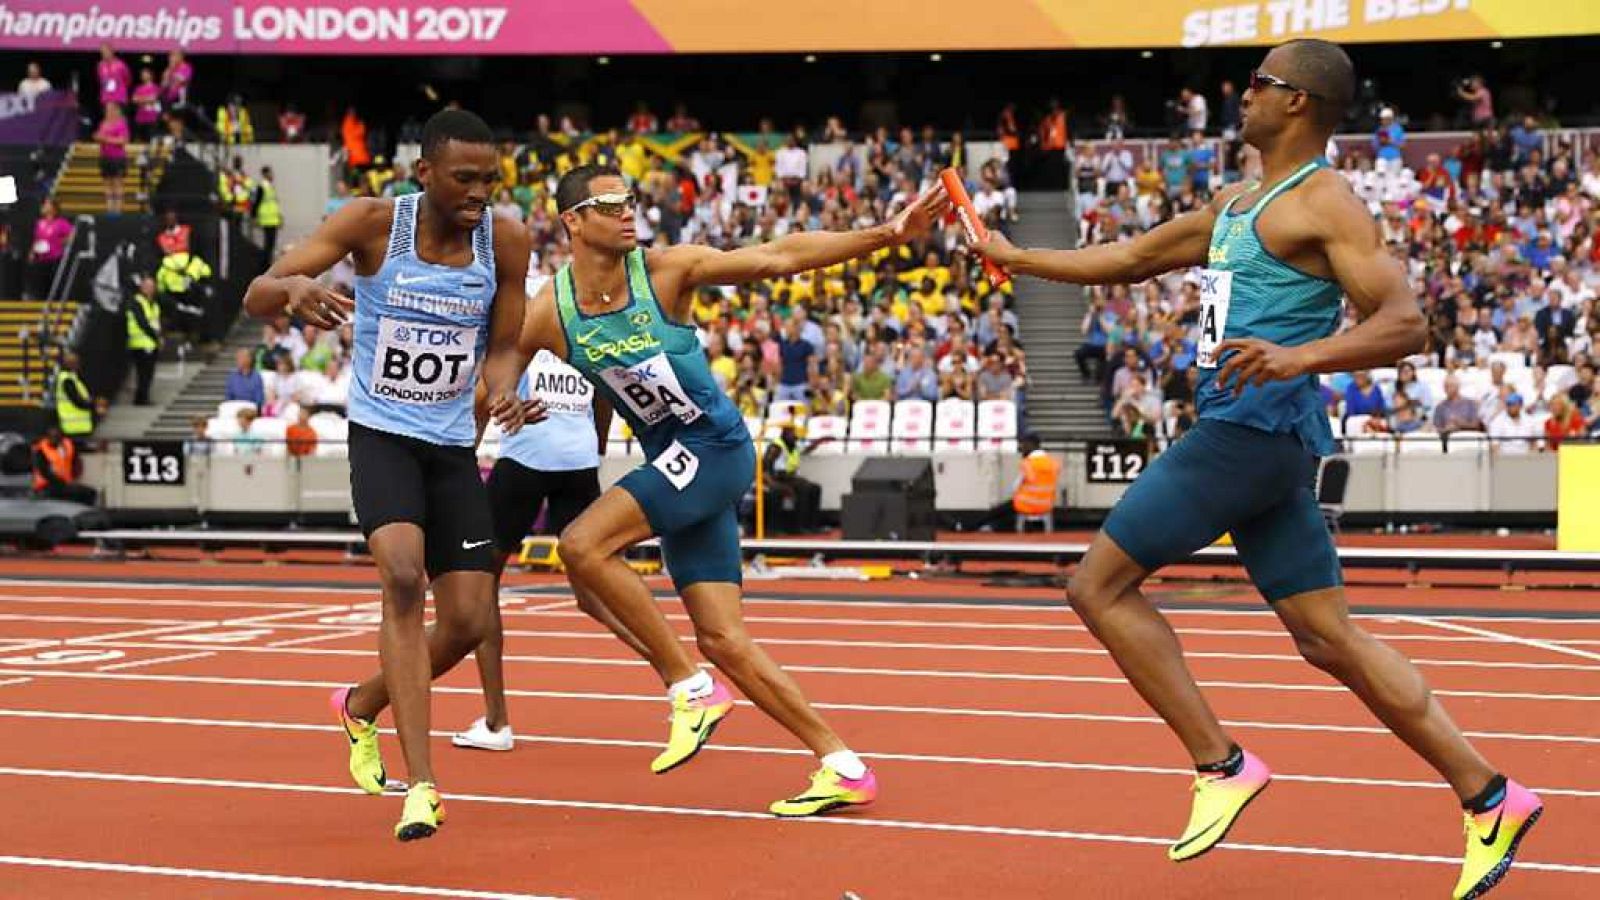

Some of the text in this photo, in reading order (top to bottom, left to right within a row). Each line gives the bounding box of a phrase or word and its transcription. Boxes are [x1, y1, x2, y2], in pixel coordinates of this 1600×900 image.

[233, 7, 409, 41] LONDON
[414, 8, 507, 42] 2017
[1182, 6, 1259, 48] SEE
[1267, 0, 1350, 36] THE
[1199, 304, 1217, 343] A
[383, 347, 468, 385] BOT
[374, 383, 434, 402] LONDON
[535, 372, 589, 396] AMOS
[128, 455, 179, 481] 113
[666, 450, 691, 475] 5
[1091, 453, 1143, 479] 112
